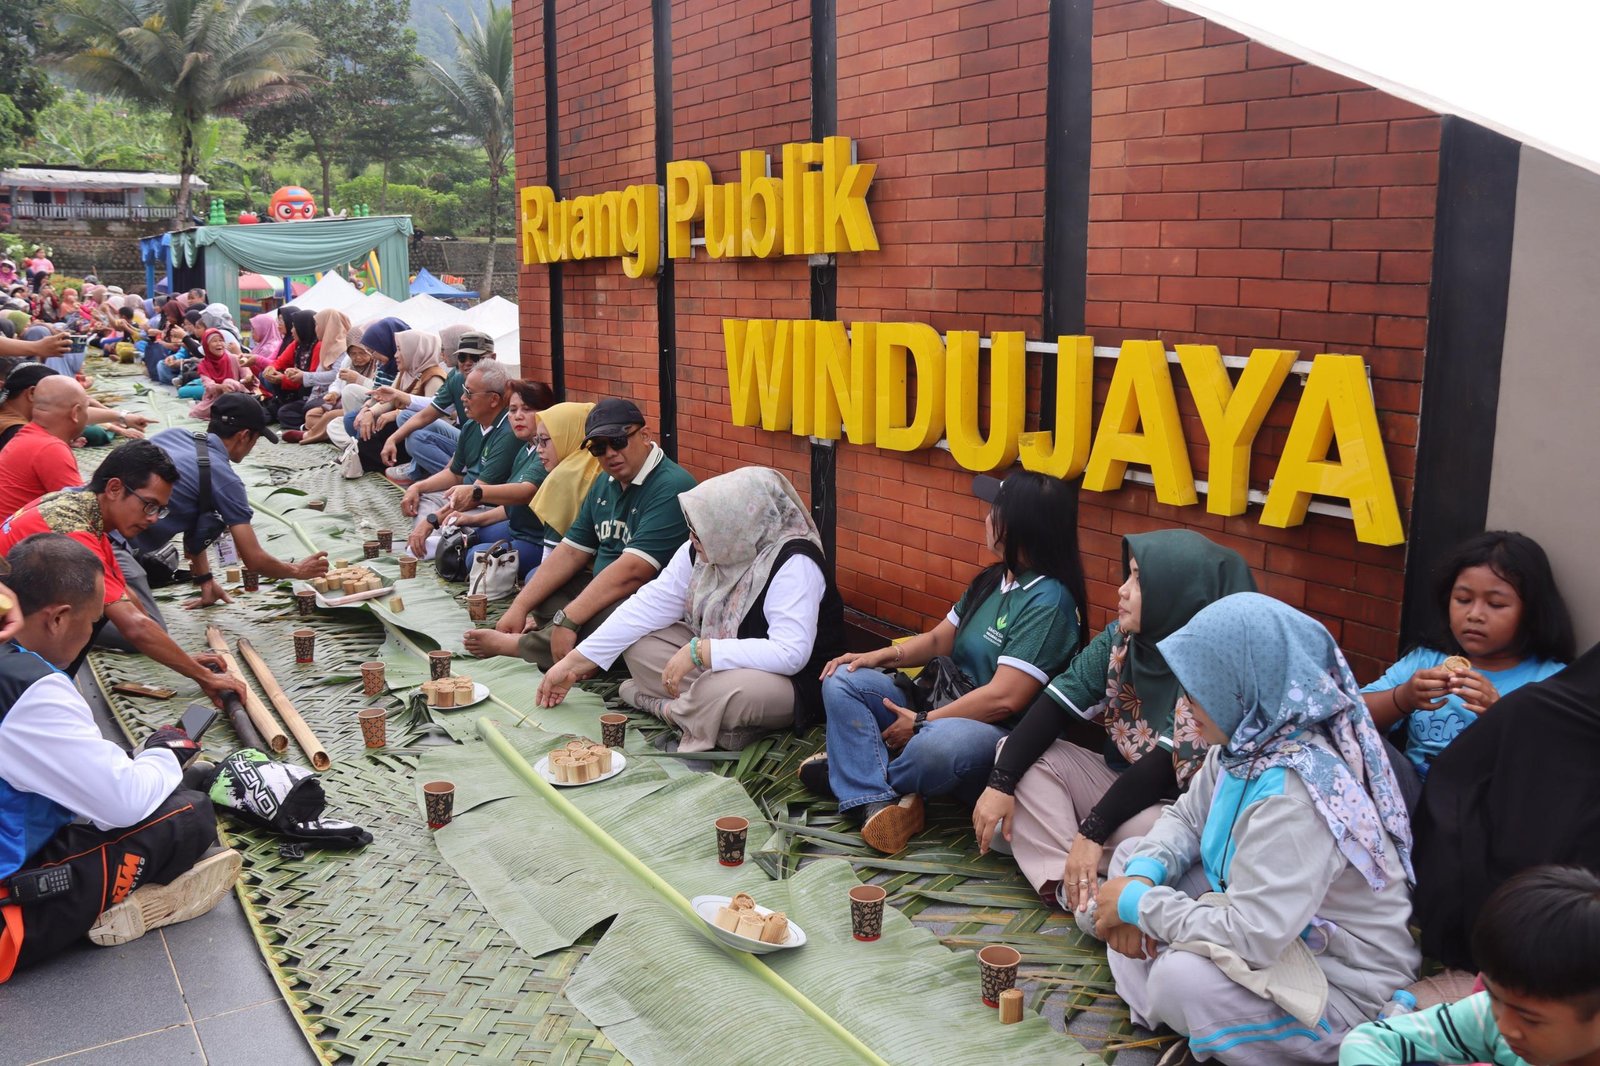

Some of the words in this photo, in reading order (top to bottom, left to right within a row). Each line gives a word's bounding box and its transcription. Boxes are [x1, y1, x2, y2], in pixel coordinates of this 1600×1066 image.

[520, 184, 661, 279] Ruang
[666, 136, 880, 259] Publik
[722, 318, 1406, 547] WINDUJAYA
[111, 852, 141, 904] KTM
